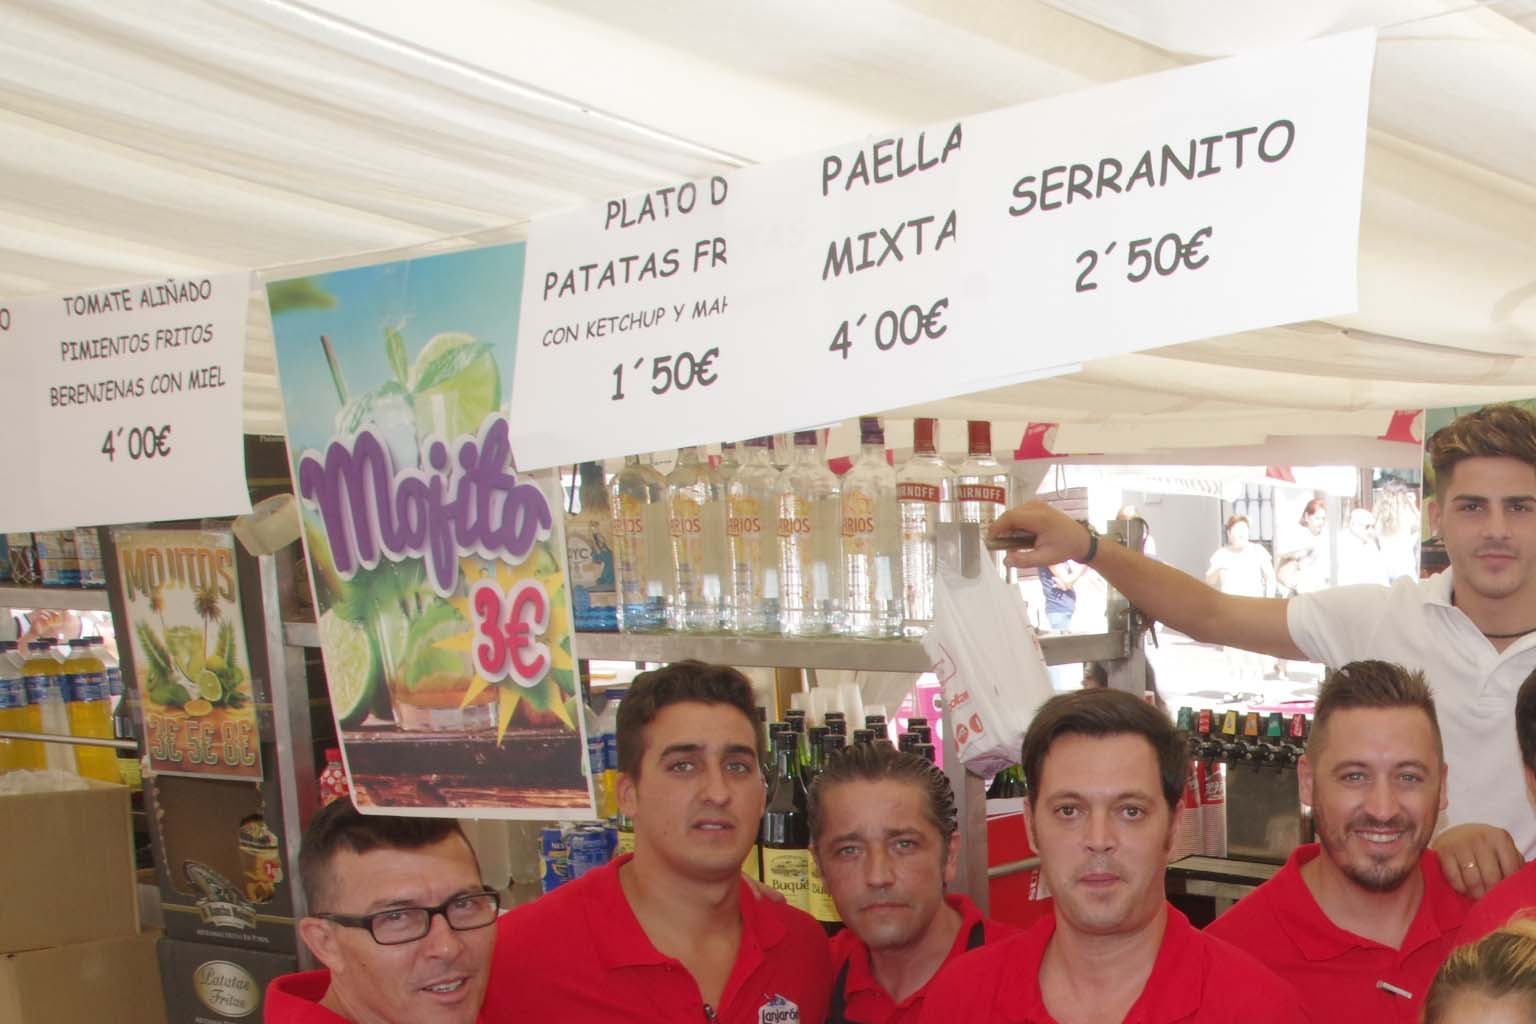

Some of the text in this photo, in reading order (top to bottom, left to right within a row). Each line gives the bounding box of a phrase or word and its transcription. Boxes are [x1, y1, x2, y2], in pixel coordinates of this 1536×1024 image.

[821, 121, 962, 196] PAELLA
[1007, 119, 1296, 217] SERRANITO
[604, 176, 728, 230] PLATO D
[543, 237, 728, 301] PATATAS FR
[821, 209, 957, 281] MIXTA
[63, 278, 212, 317] TOMATE ALIÑADO
[542, 324, 579, 347] CON
[586, 307, 666, 338] KETCHUP
[674, 303, 685, 322] Y
[61, 323, 213, 361] PIMIENTOS FRITOS
[50, 365, 226, 407] BERENJENAS CON MIEL
[298, 415, 554, 594] Mojito
[122, 547, 236, 604] MOJITOS
[473, 584, 548, 682] 3€
